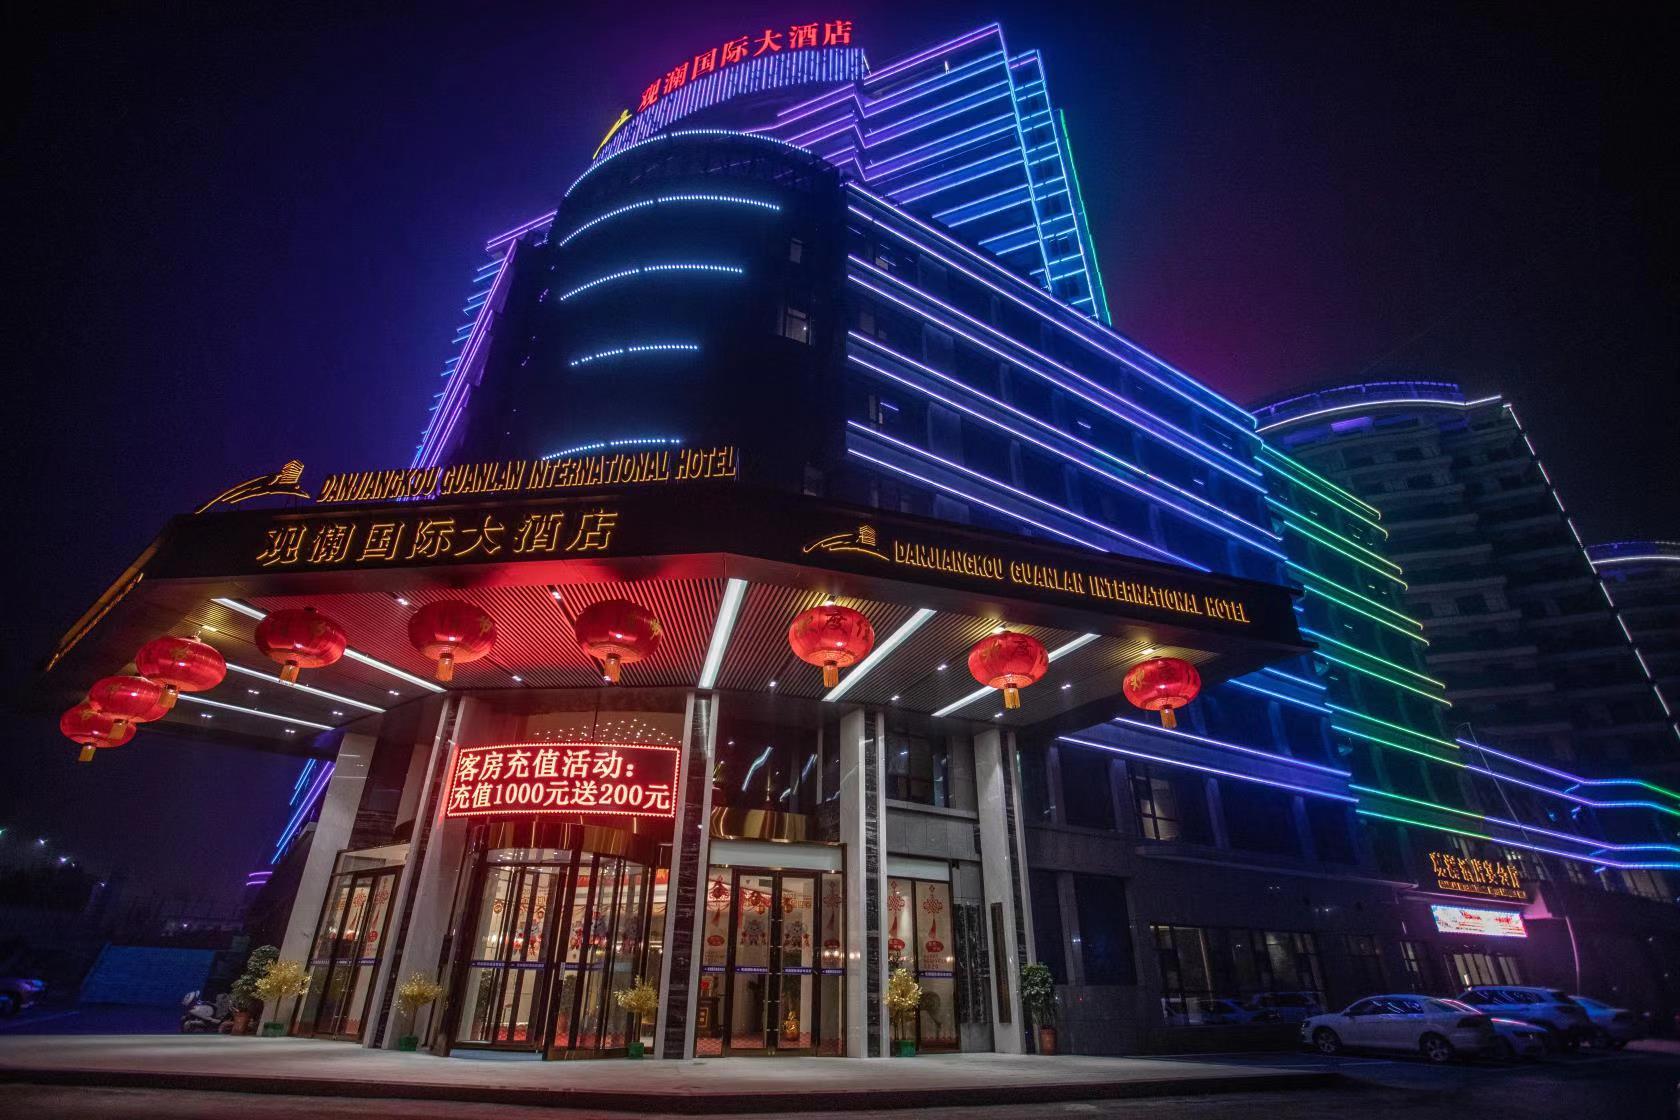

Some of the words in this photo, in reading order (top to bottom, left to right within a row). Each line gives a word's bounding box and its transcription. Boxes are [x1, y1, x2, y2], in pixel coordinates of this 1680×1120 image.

[637, 20, 853, 113] 观澜国际大酒店
[317, 466, 443, 503] DANJIANGKOU
[441, 460, 526, 495] GUANLAN
[526, 451, 669, 490] INTERNATIONAL
[675, 446, 736, 480] HOTEL
[256, 508, 618, 567] 观澜国际大酒店
[895, 539, 1004, 580] DANJIANGKOU
[1011, 560, 1086, 594] GUANLAN
[1089, 575, 1203, 615] INTERNATIONAL
[1205, 596, 1251, 623] HOTEL
[450, 780, 671, 810] 充值1000元送200元
